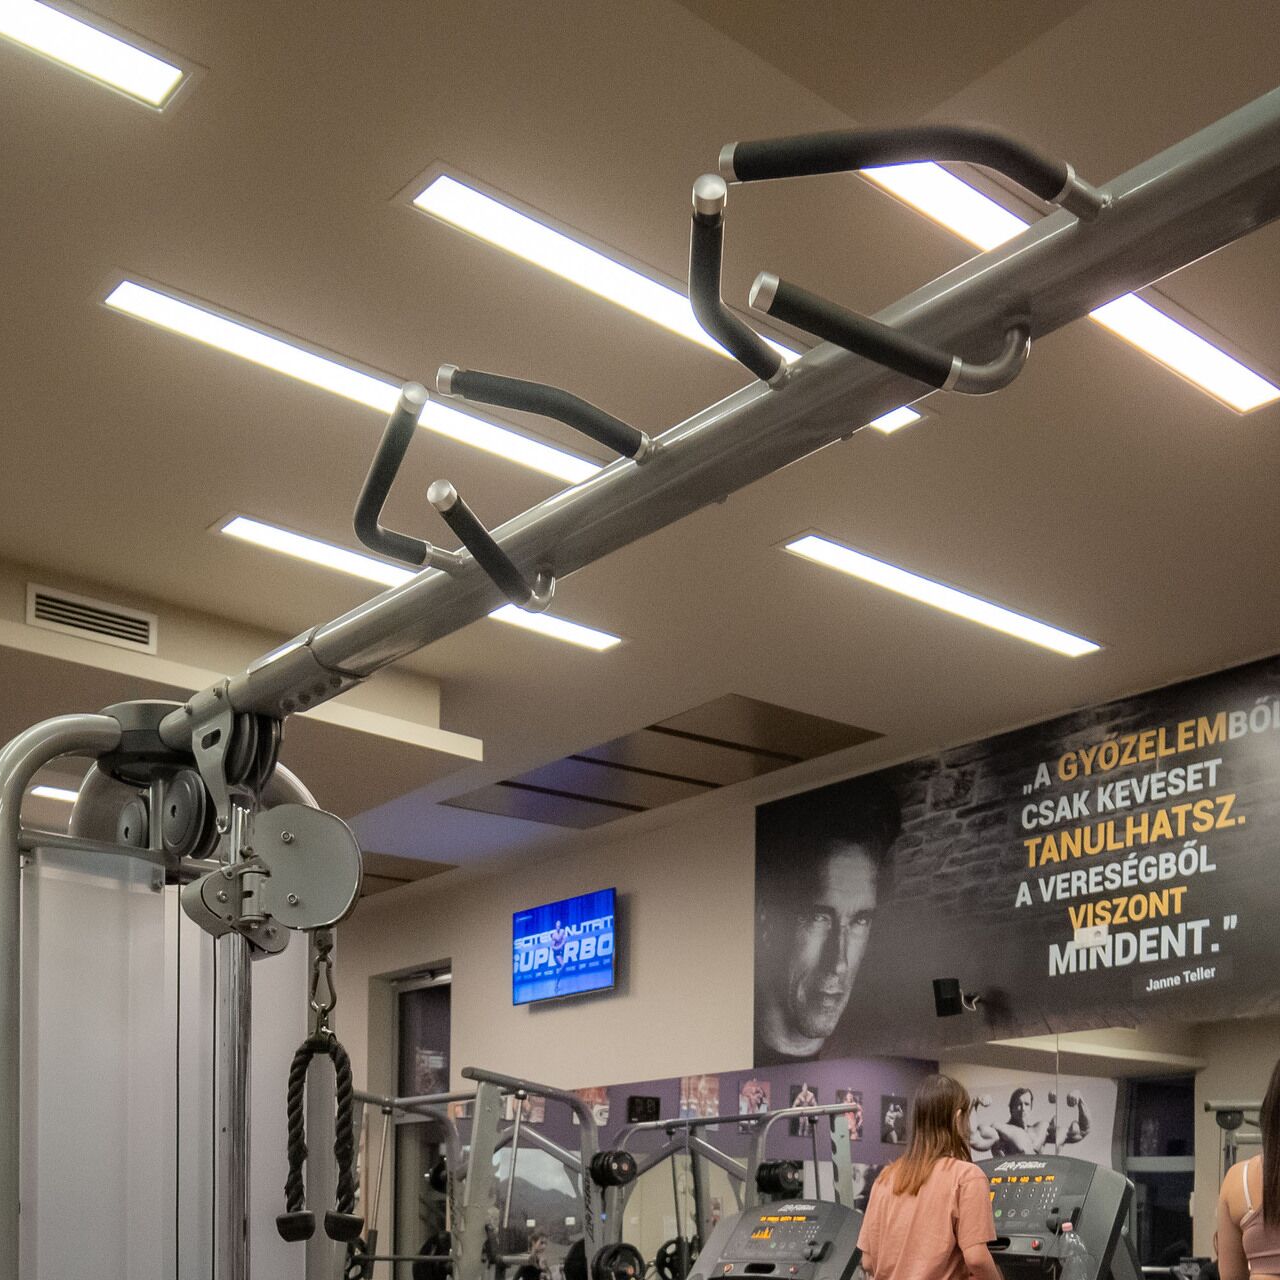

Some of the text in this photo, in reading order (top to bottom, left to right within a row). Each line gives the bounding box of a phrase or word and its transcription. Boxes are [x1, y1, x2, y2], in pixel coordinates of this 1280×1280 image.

[1021, 757, 1223, 830] CSAK KEVESET
[1023, 794, 1247, 868] TANULHATSZ.
[1014, 840, 1217, 908] A VERESÉGBŐL
[1068, 886, 1188, 931] VISZONT
[1145, 965, 1216, 992] Janne Teller
